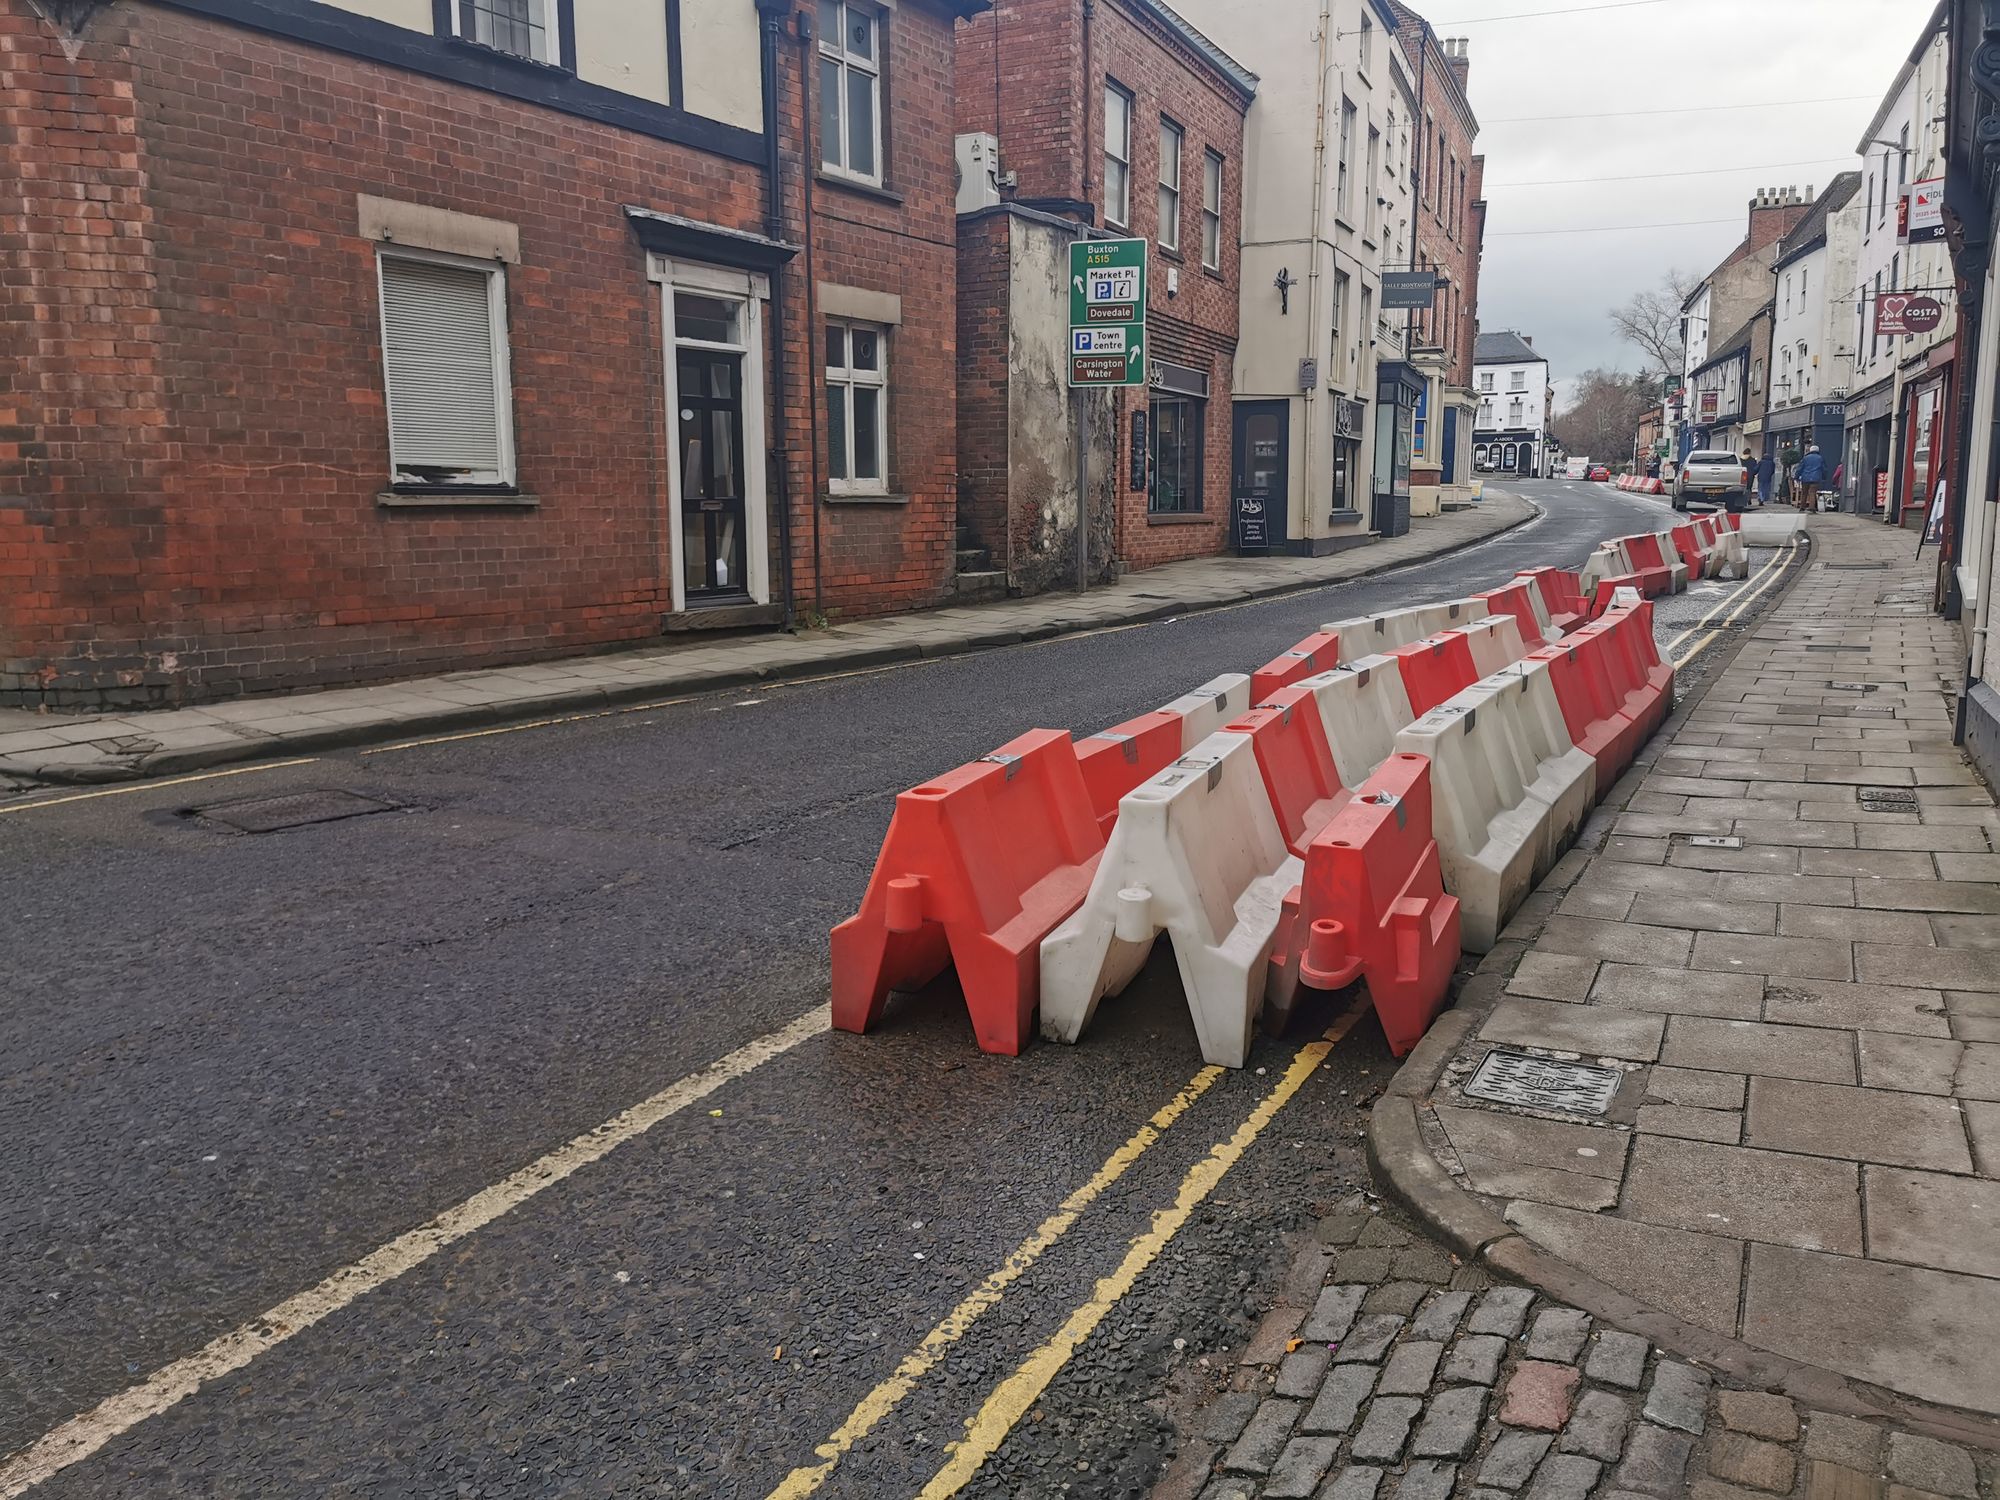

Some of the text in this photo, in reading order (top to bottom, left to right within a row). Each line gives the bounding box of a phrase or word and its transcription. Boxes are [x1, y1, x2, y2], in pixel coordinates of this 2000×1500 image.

[1087, 245, 1119, 254] Buxton
[1090, 270, 1137, 280] Market Pl.
[1090, 308, 1131, 318] Dovedale
[1905, 308, 1938, 317] COSTA
[1097, 331, 1120, 340] Town
[1079, 334, 1090, 349] P
[1094, 341, 1123, 350] centre
[1075, 360, 1123, 370] Carsington
[1086, 370, 1112, 378] Water
